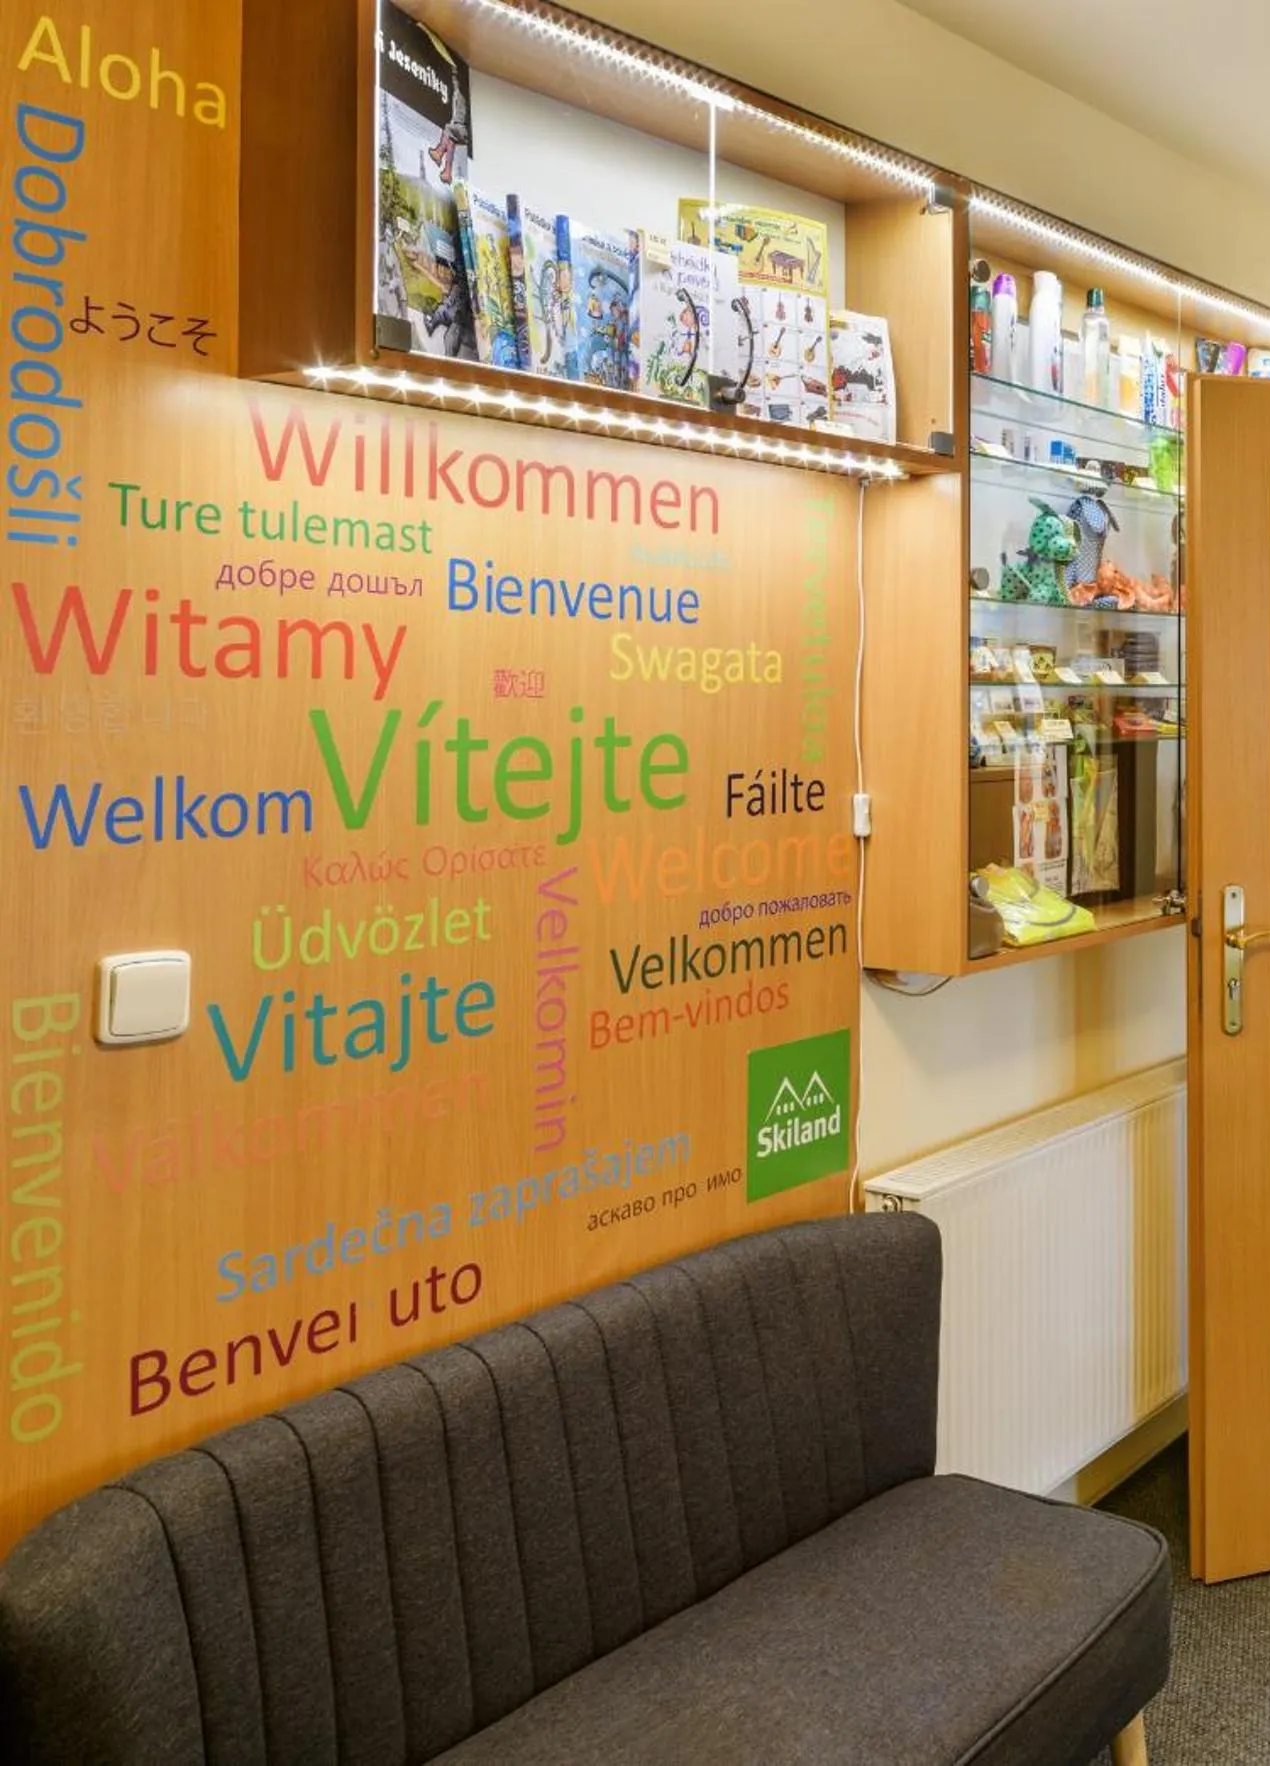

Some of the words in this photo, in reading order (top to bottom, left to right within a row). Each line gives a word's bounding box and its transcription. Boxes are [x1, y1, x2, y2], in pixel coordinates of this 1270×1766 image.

[17, 15, 227, 129] Aloha
[7, 103, 86, 547] Dobrodošli
[69, 296, 217, 356] ようこそ
[248, 398, 719, 534] Willkommen
[108, 482, 222, 535] Ture
[238, 501, 432, 554] tulemast
[215, 560, 315, 595] добре
[327, 570, 424, 597] дошъл
[448, 557, 700, 624] Bienvenue
[11, 582, 408, 701] Witamy
[610, 632, 783, 694] Swagata
[494, 668, 545, 699] 歡迎
[309, 700, 690, 845] Vítejte
[727, 769, 825, 817] Fáilte
[19, 775, 313, 849] Welkom
[587, 826, 850, 904] Welcome
[252, 897, 490, 971] Üdvözlet
[699, 902, 754, 928] добро
[758, 891, 852, 917] пожаловать
[610, 922, 847, 994] Velkommen
[206, 973, 495, 1082] Vitajte
[534, 867, 580, 1152] Velkomin
[590, 980, 790, 1050] Bem-vindos
[756, 1105, 842, 1159] Skiland
[9, 993, 82, 1444] Bienvenido
[215, 1198, 452, 1302] Sardečna
[468, 1132, 691, 1228] zaprašajem
